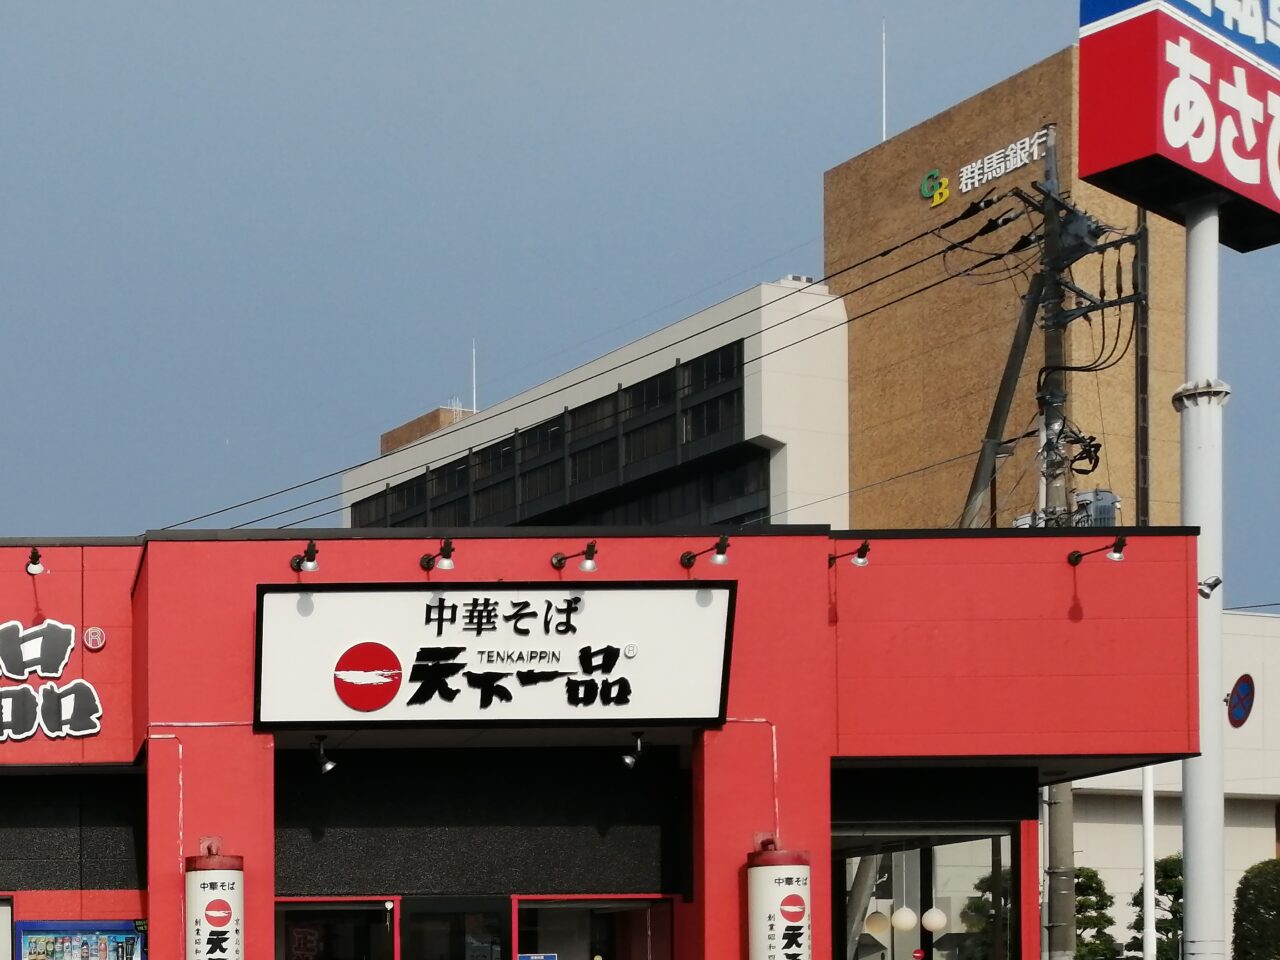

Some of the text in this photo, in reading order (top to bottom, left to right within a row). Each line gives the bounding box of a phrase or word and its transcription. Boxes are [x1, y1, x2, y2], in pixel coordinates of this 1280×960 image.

[425, 597, 581, 637] 中華そば
[477, 650, 561, 664] TENKAIPPIN
[407, 645, 632, 709] 天下一品
[200, 881, 236, 891] 中華そば
[774, 876, 808, 887] 中華そば
